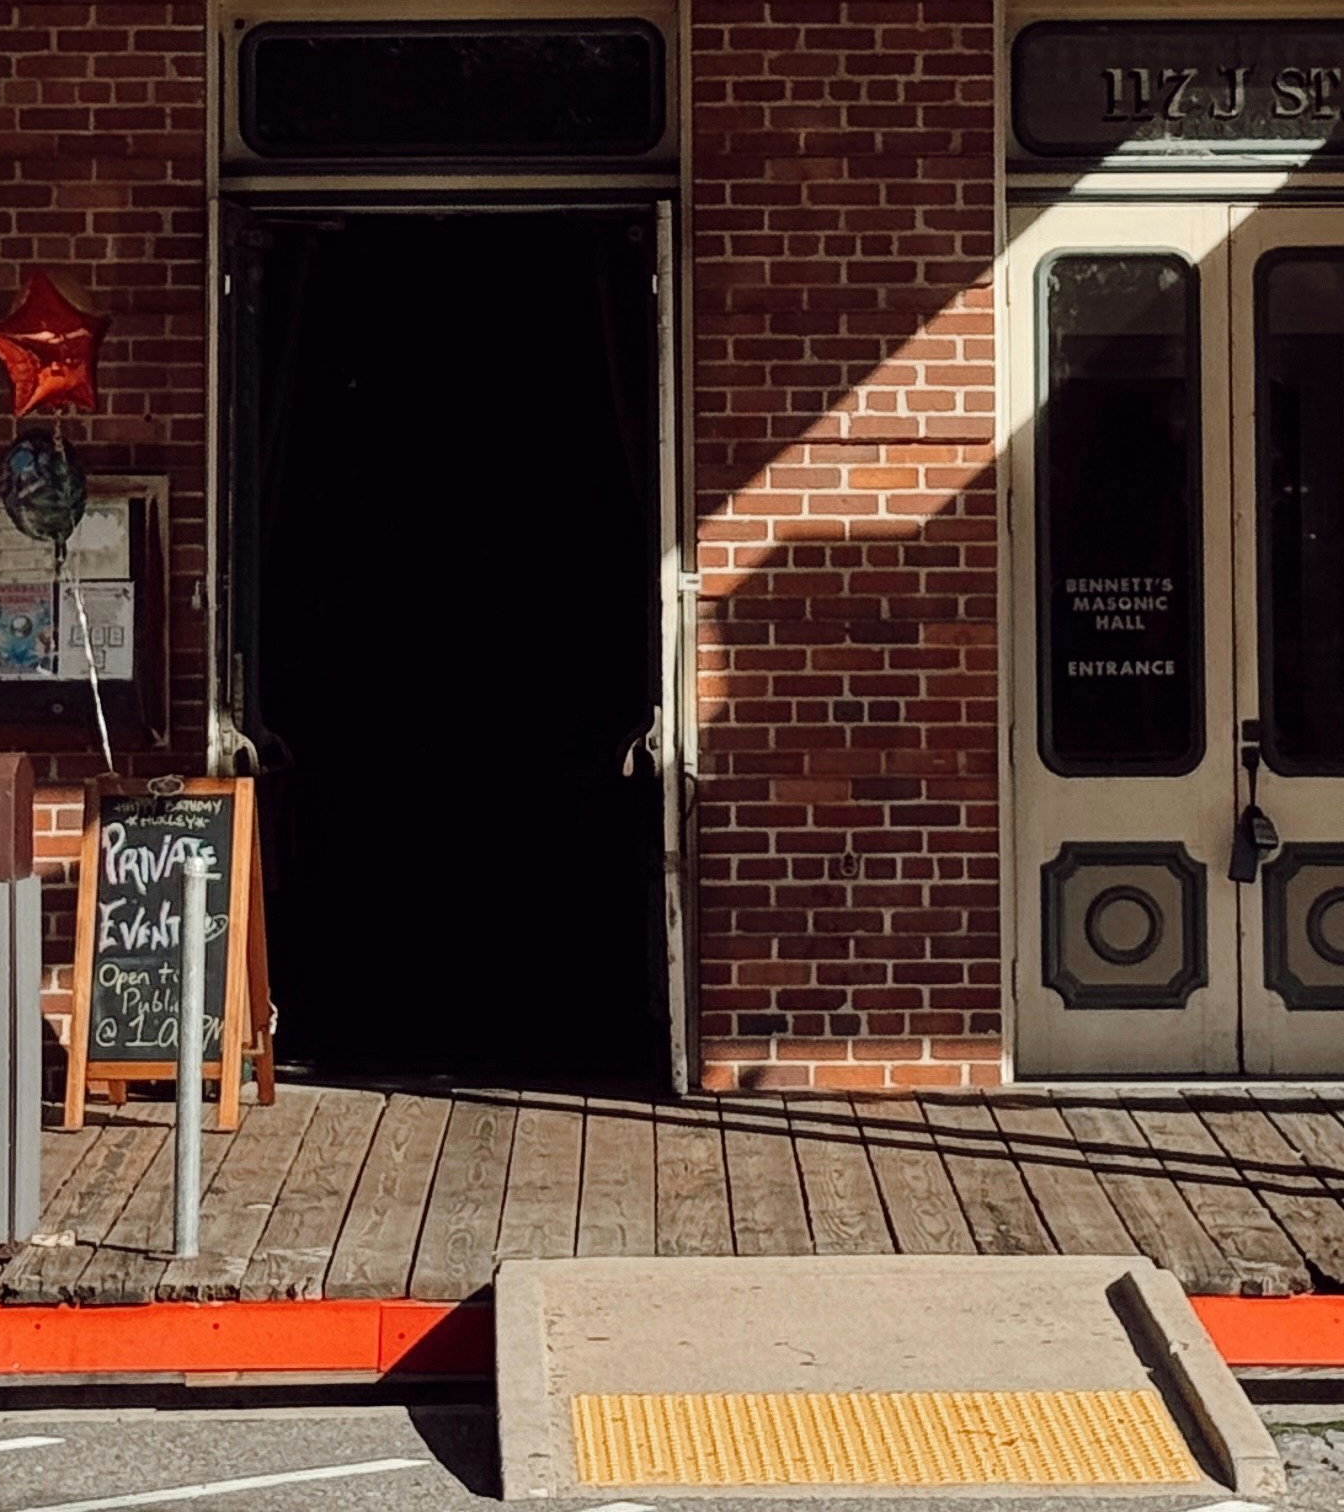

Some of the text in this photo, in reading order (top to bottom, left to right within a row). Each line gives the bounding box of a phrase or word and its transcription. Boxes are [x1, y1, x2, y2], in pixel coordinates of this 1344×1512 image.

[1101, 66, 1199, 122] 117
[1208, 65, 1257, 121] J
[1065, 577, 1174, 593] BENNETT'S
[1072, 596, 1169, 612] MASONIC
[1095, 615, 1146, 631] HALL
[1067, 660, 1176, 677] ENTRANCE
[101, 821, 218, 896] PRIVATE
[98, 896, 182, 954] EVENT
[98, 963, 150, 995] Open
[95, 1017, 118, 1048] @
